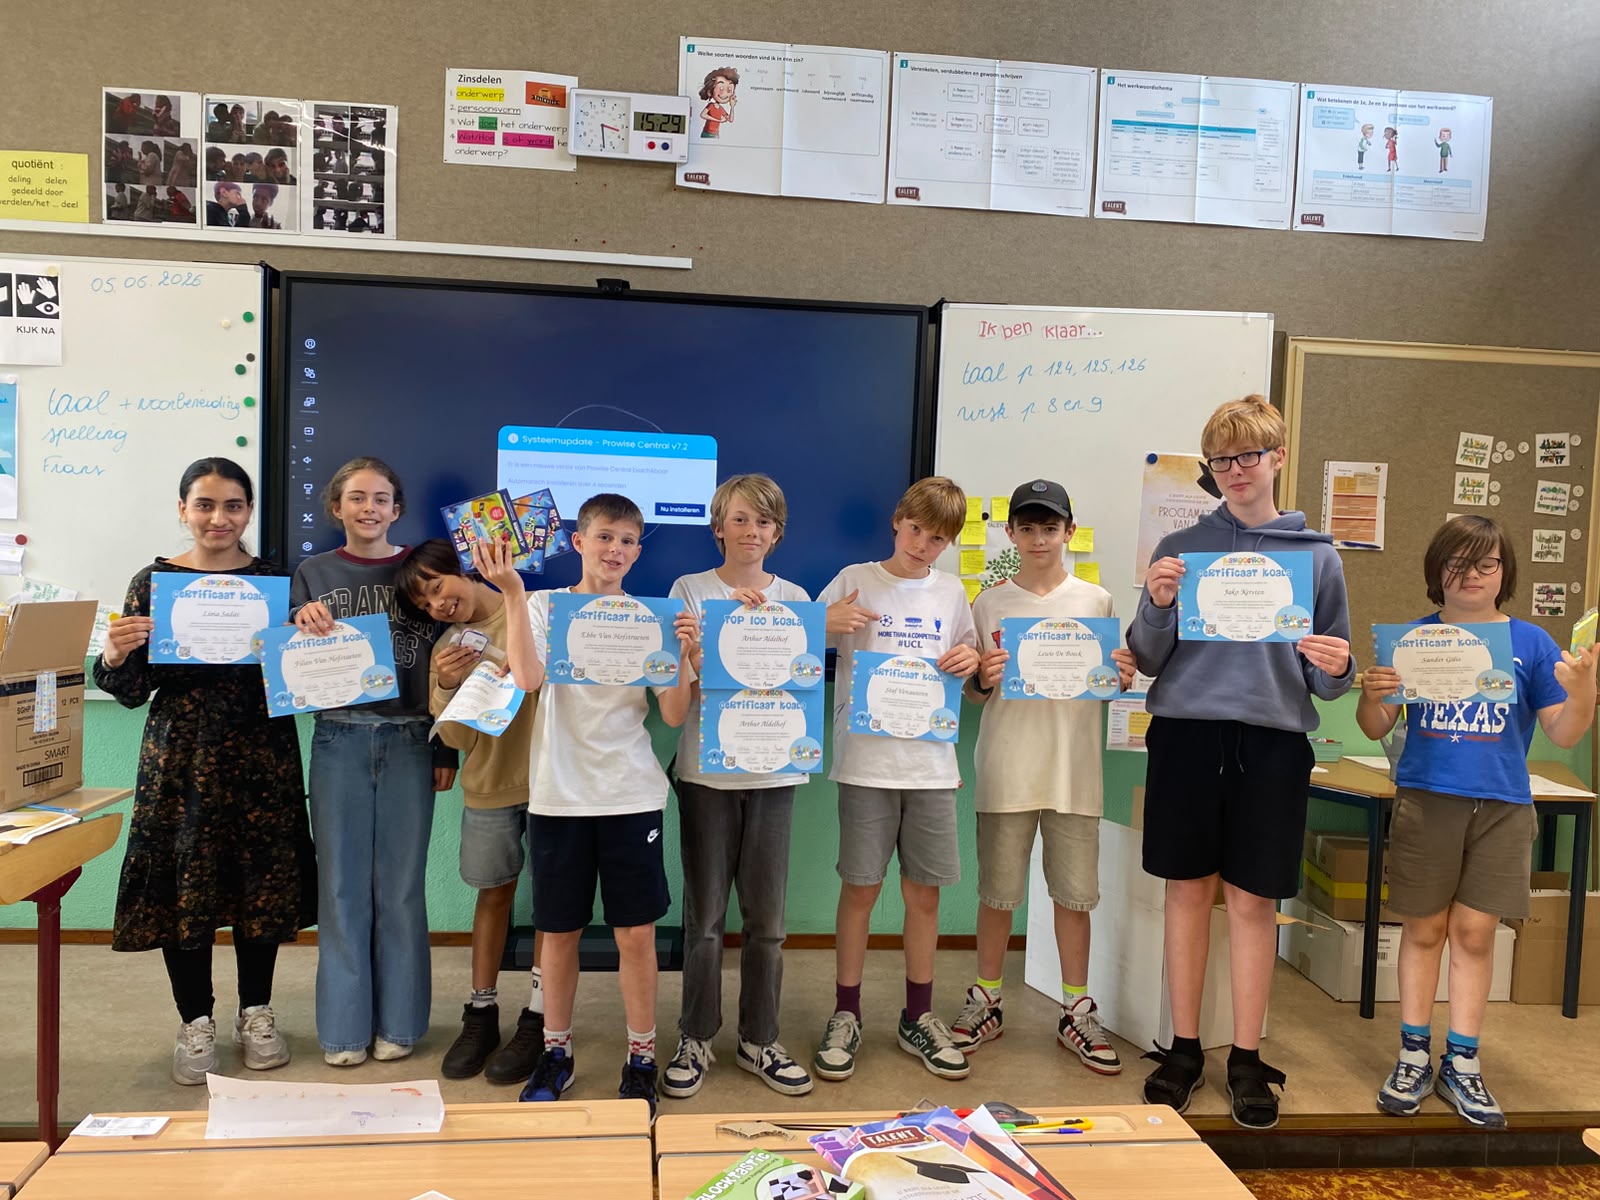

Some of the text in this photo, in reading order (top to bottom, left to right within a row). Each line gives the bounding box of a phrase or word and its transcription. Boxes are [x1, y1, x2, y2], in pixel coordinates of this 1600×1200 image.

[458, 74, 502, 84] Zinsdelen
[456, 90, 504, 101] onderwerp
[458, 105, 520, 114] persoonsvorm
[500, 120, 515, 129] het
[519, 122, 568, 136] onderwerp
[455, 149, 509, 159] onderwerp?
[12, 159, 54, 170] quotiënt
[8, 175, 31, 185] deling
[687, 174, 706, 182] TALENT
[12, 187, 42, 196] gedeeld
[898, 188, 917, 196] TALENT
[16, 325, 55, 335] KIJK NA
[979, 321, 997, 337] Ik
[1003, 321, 1032, 339] ben
[962, 362, 1008, 385] taal
[1117, 358, 1147, 372] 126
[48, 388, 110, 416] taal
[1048, 398, 1058, 413] 8
[1064, 400, 1082, 411] en
[1086, 396, 1102, 413] 9
[41, 425, 128, 452] spelling
[522, 435, 593, 446] Systeemupdate
[602, 440, 636, 448] Prowise
[638, 441, 670, 449] Central
[724, 615, 744, 625] TOP
[750, 616, 766, 625] 100
[898, 640, 923, 648] #UCL
[1418, 702, 1510, 733] TEXAS
[45, 746, 70, 760] SMART
[866, 1130, 915, 1144] TALENT
